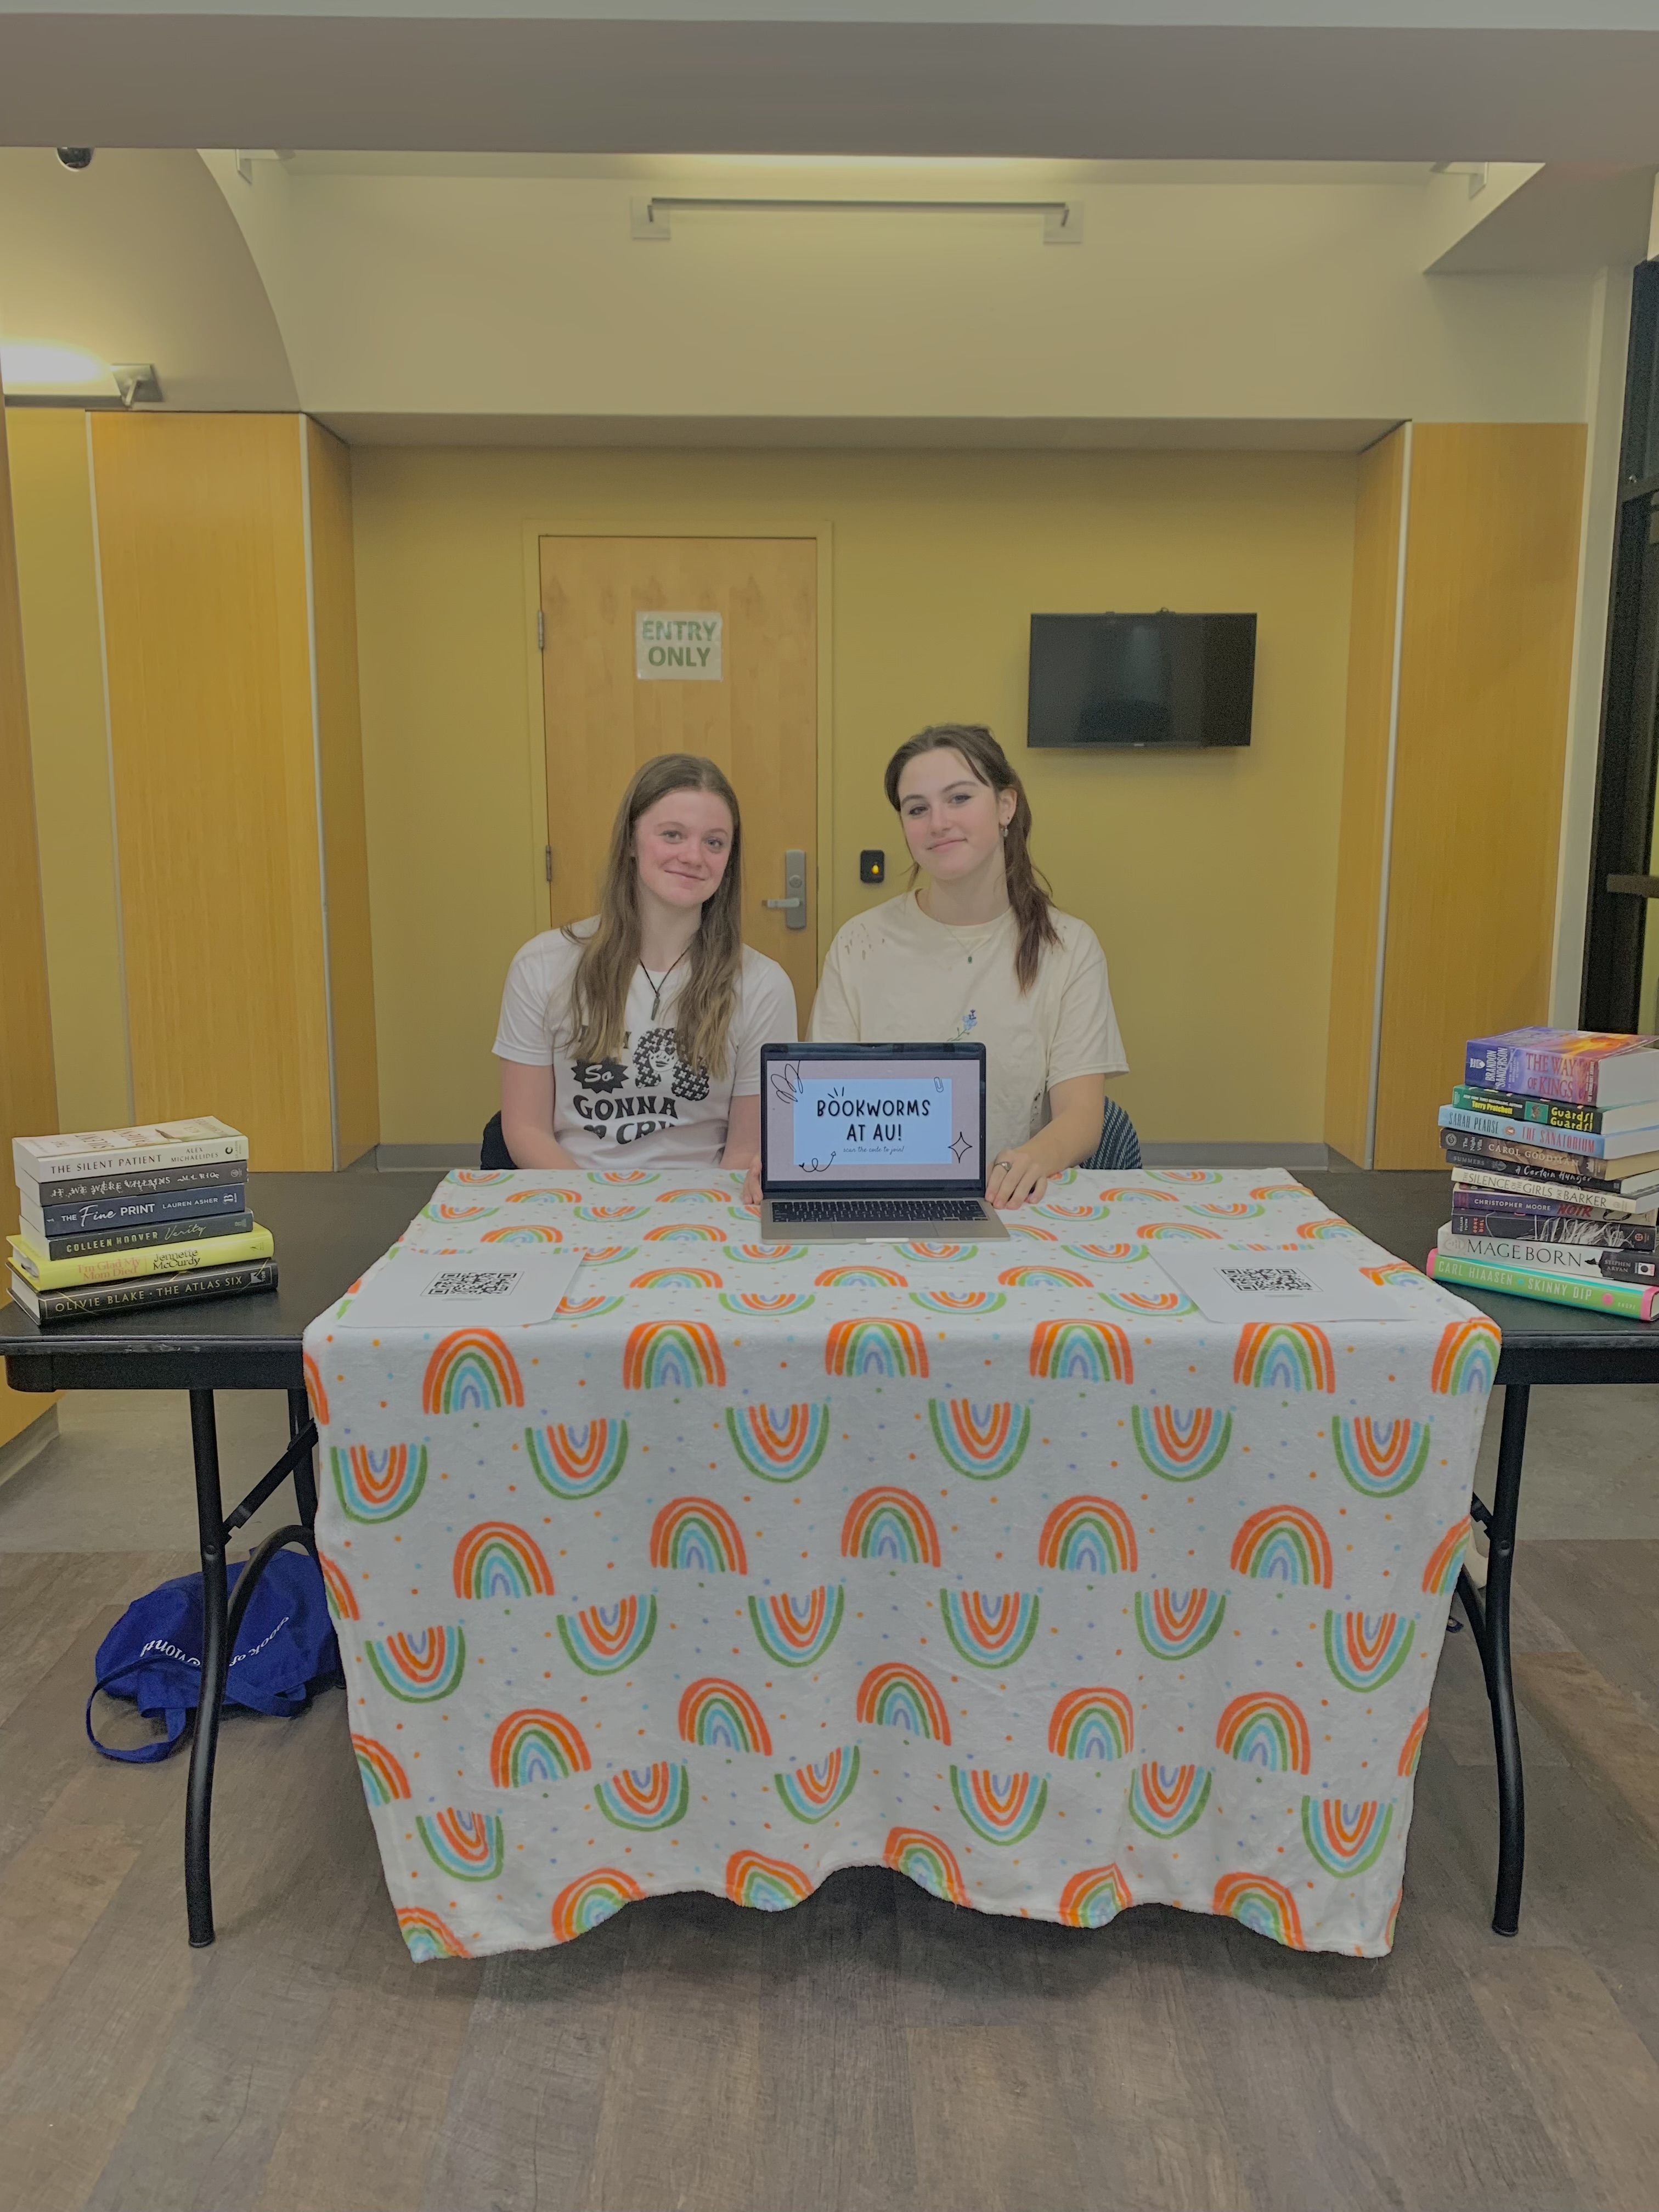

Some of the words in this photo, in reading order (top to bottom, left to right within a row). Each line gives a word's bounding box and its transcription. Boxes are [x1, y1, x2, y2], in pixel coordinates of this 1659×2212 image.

[642, 620, 717, 641] ENTRY
[648, 646, 710, 667] ONLY
[584, 1064, 614, 1082] So
[1485, 1049, 1497, 1082] BRANDON
[1495, 1047, 1508, 1088] SANDERSON
[1526, 1052, 1548, 1072] THE
[1551, 1056, 1576, 1077] WAY
[1528, 1077, 1537, 1089] OF
[1539, 1076, 1573, 1098] KINGS
[573, 1094, 678, 1120] GONNA
[817, 1099, 930, 1117] BOOKWORMS
[1472, 1101, 1486, 1110] Terry
[1486, 1103, 1513, 1114] Pratchett
[1551, 1107, 1594, 1122] Guards!
[616, 1121, 675, 1144] CR
[846, 1124, 866, 1142] AT
[873, 1124, 902, 1142] AU!
[1448, 1112, 1470, 1127] SARAH
[1474, 1117, 1499, 1135] PEARSE
[1550, 1119, 1593, 1132] Guards!
[1522, 1126, 1535, 1141] THE
[1540, 1131, 1595, 1153] SANATORIUM
[50, 1165, 71, 1175] THE
[77, 1160, 114, 1172] SILENT
[119, 1155, 162, 1167] PATIENT
[171, 1152, 219, 1163] MICHAELIDES
[1453, 1155, 1485, 1166] SUMMERS
[1488, 1144, 1521, 1157] CAROL
[1525, 1150, 1579, 1166] GOODMAN
[1516, 1166, 1521, 1175] A
[1523, 1165, 1555, 1179] Certain
[1559, 1171, 1592, 1184] Hunger
[66, 1185, 88, 1197] WE
[91, 1180, 122, 1195] WERE
[123, 1176, 171, 1192] VILLAINS
[1469, 1173, 1510, 1189] SILENCE
[1523, 1183, 1553, 1198] GIRLS
[162, 1200, 193, 1210] LAUREN
[194, 1197, 219, 1206] ASHER
[1474, 1198, 1523, 1209] CHRISTOPHER
[1526, 1203, 1551, 1211] MOORE
[1564, 1192, 1607, 1207] BARKER
[61, 1214, 77, 1222] THE
[79, 1204, 116, 1227] Fine
[120, 1203, 156, 1216] PRINT
[66, 1239, 112, 1253] COLLEEN
[116, 1231, 159, 1245] HOOVER
[165, 1224, 206, 1241] Verity
[153, 1257, 201, 1272] McCurdy
[154, 1249, 199, 1262] Jennette
[77, 1265, 94, 1274] I'm
[95, 1260, 123, 1272] Glad
[125, 1258, 141, 1272] My
[83, 1271, 111, 1282] Mom
[112, 1267, 138, 1278] Died
[1438, 1261, 1464, 1276] CARL
[1469, 1267, 1513, 1285] HIAASEN
[1527, 1278, 1568, 1296] SKINNY
[1572, 1286, 1592, 1300] DIP
[55, 1297, 100, 1313] OLIVIE
[108, 1291, 145, 1305] BLAKE
[157, 1285, 179, 1297] THE
[185, 1279, 221, 1292] ATLAS
[225, 1276, 242, 1286] SIX
